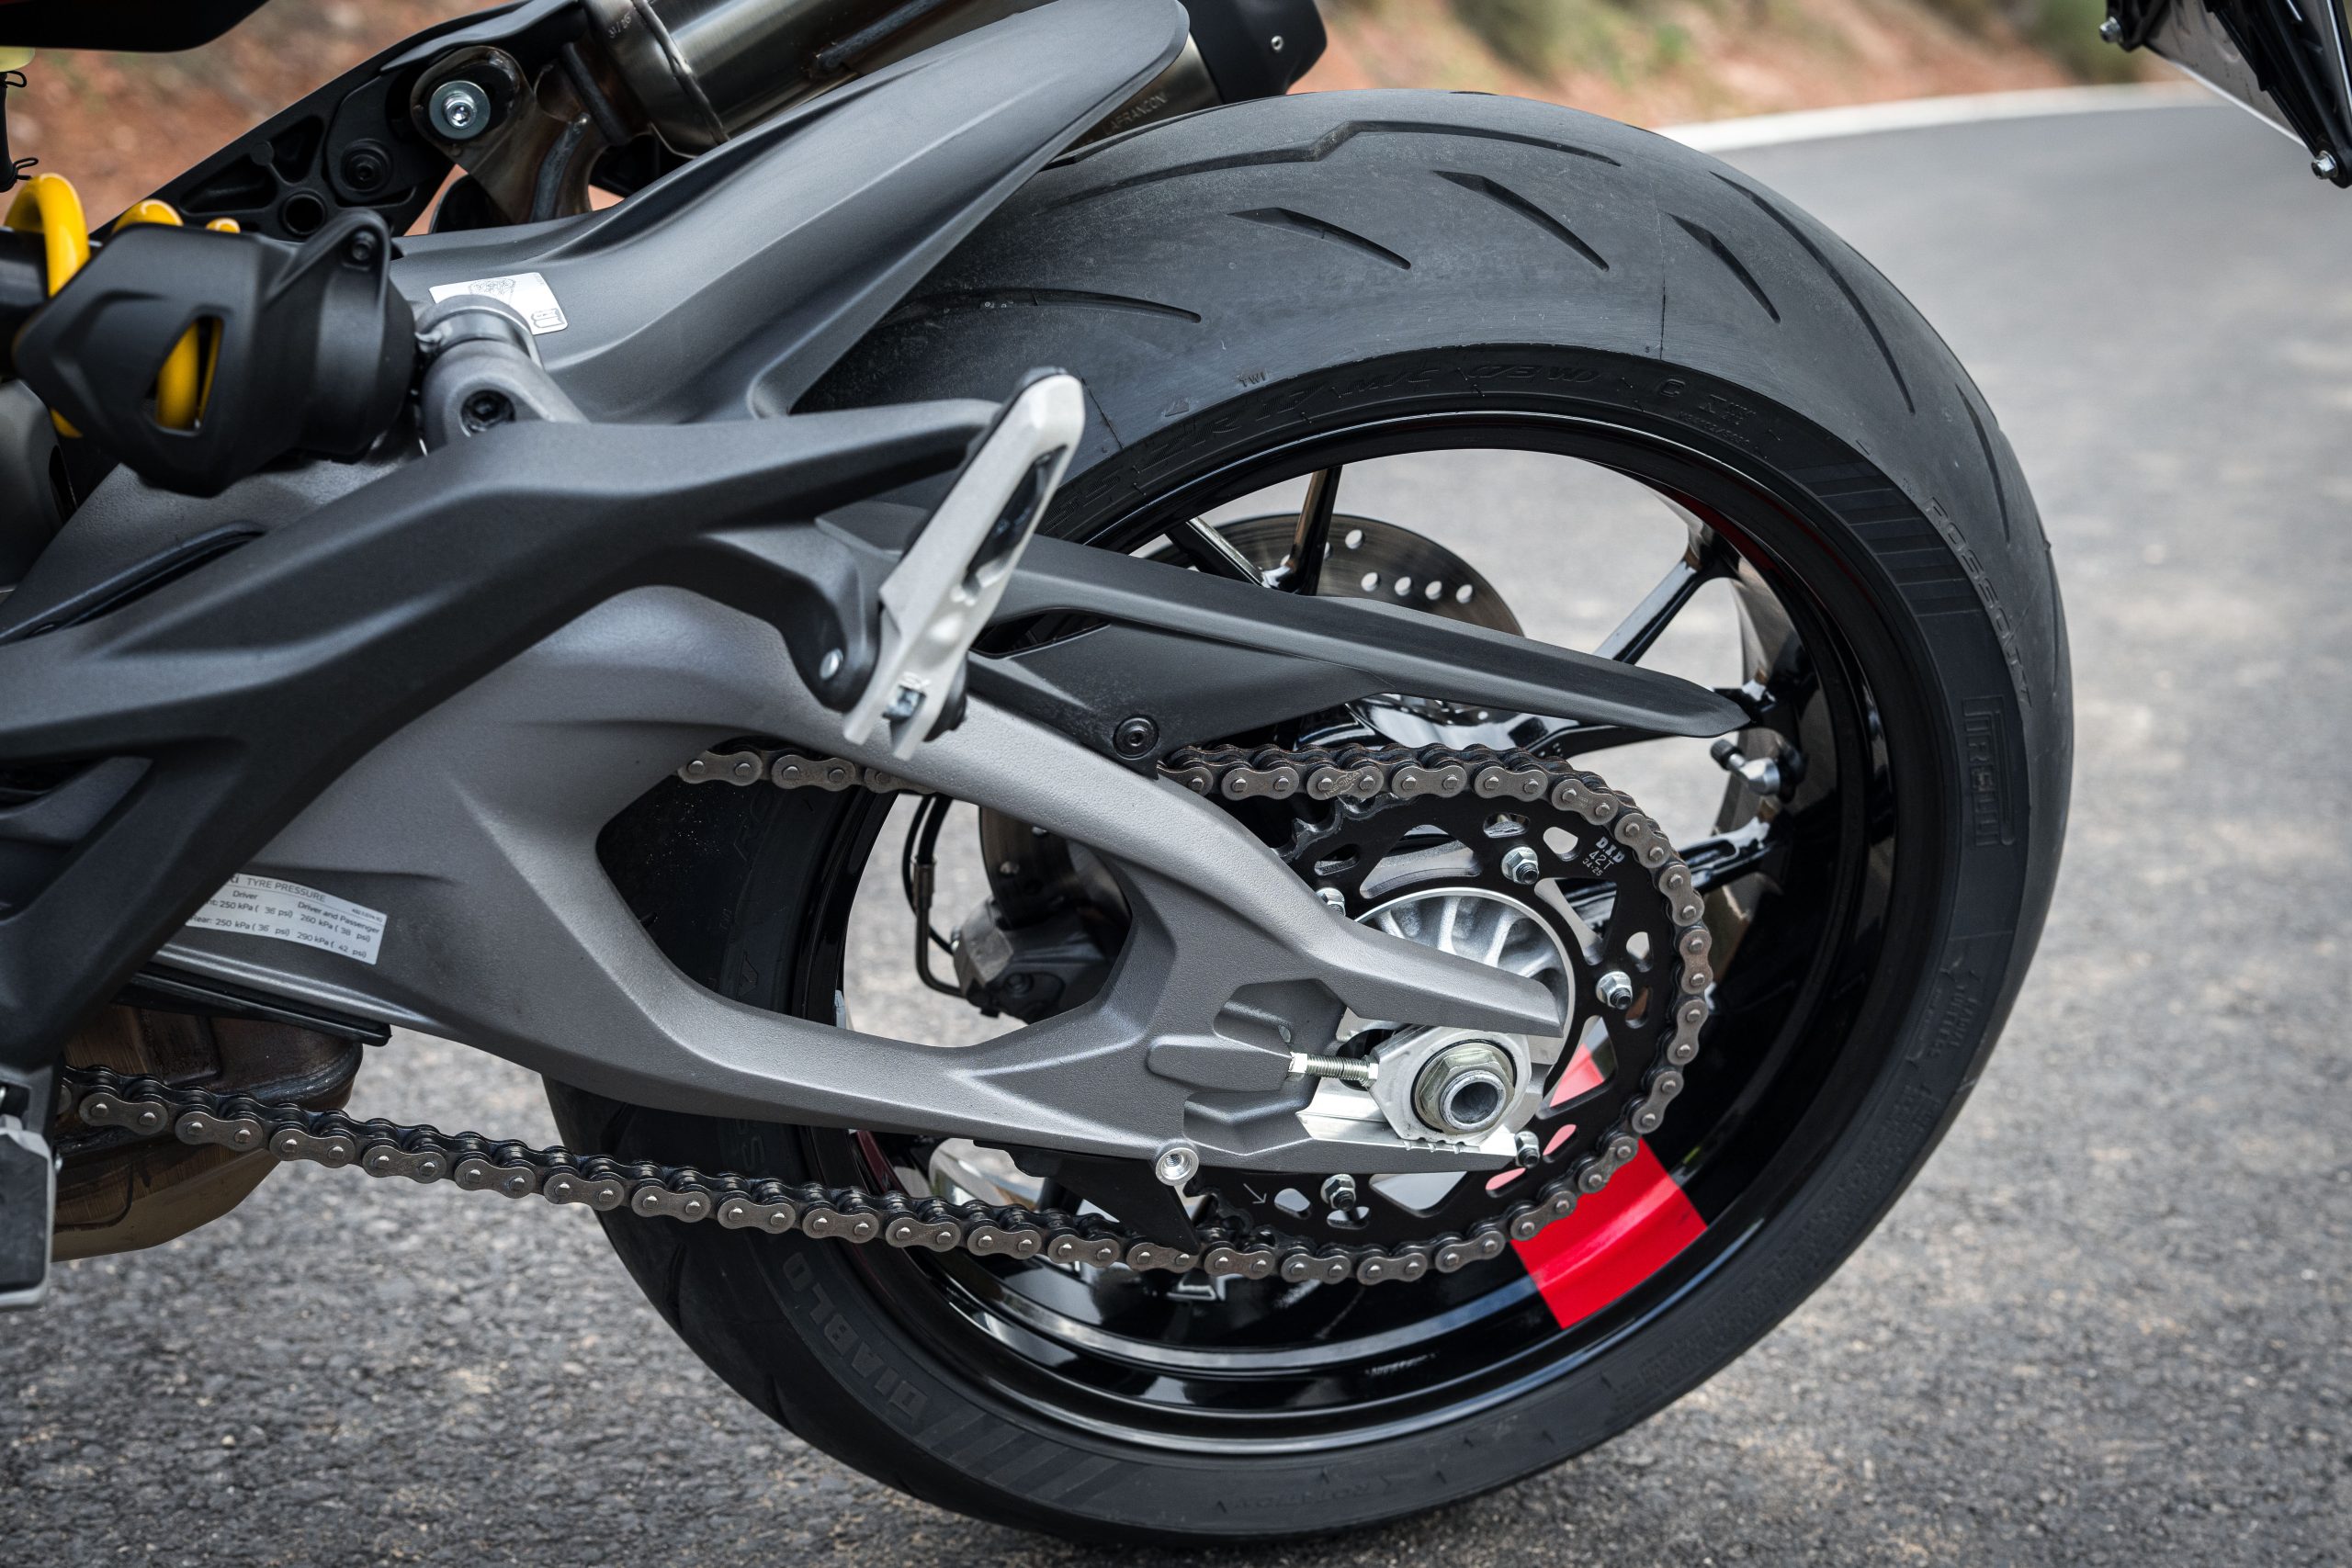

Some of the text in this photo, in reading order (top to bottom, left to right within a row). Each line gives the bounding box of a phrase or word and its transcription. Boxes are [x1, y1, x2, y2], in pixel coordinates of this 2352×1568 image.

[1925, 495, 2013, 641] ROSSO
[1589, 851, 1614, 870] 42T
[232, 890, 258, 900] Driver
[246, 877, 272, 889] TYRE
[275, 882, 326, 902] PRESSURE
[220, 900, 236, 909] 250
[238, 903, 254, 912] kPa
[216, 918, 232, 927] 250
[234, 921, 250, 931] kPa
[298, 901, 322, 914] Driver
[322, 909, 338, 919] and
[340, 914, 380, 934] Passenger
[319, 919, 334, 931] kPa
[297, 931, 313, 942] 290
[314, 936, 329, 946] kPa
[783, 1251, 932, 1424] DIABLO
